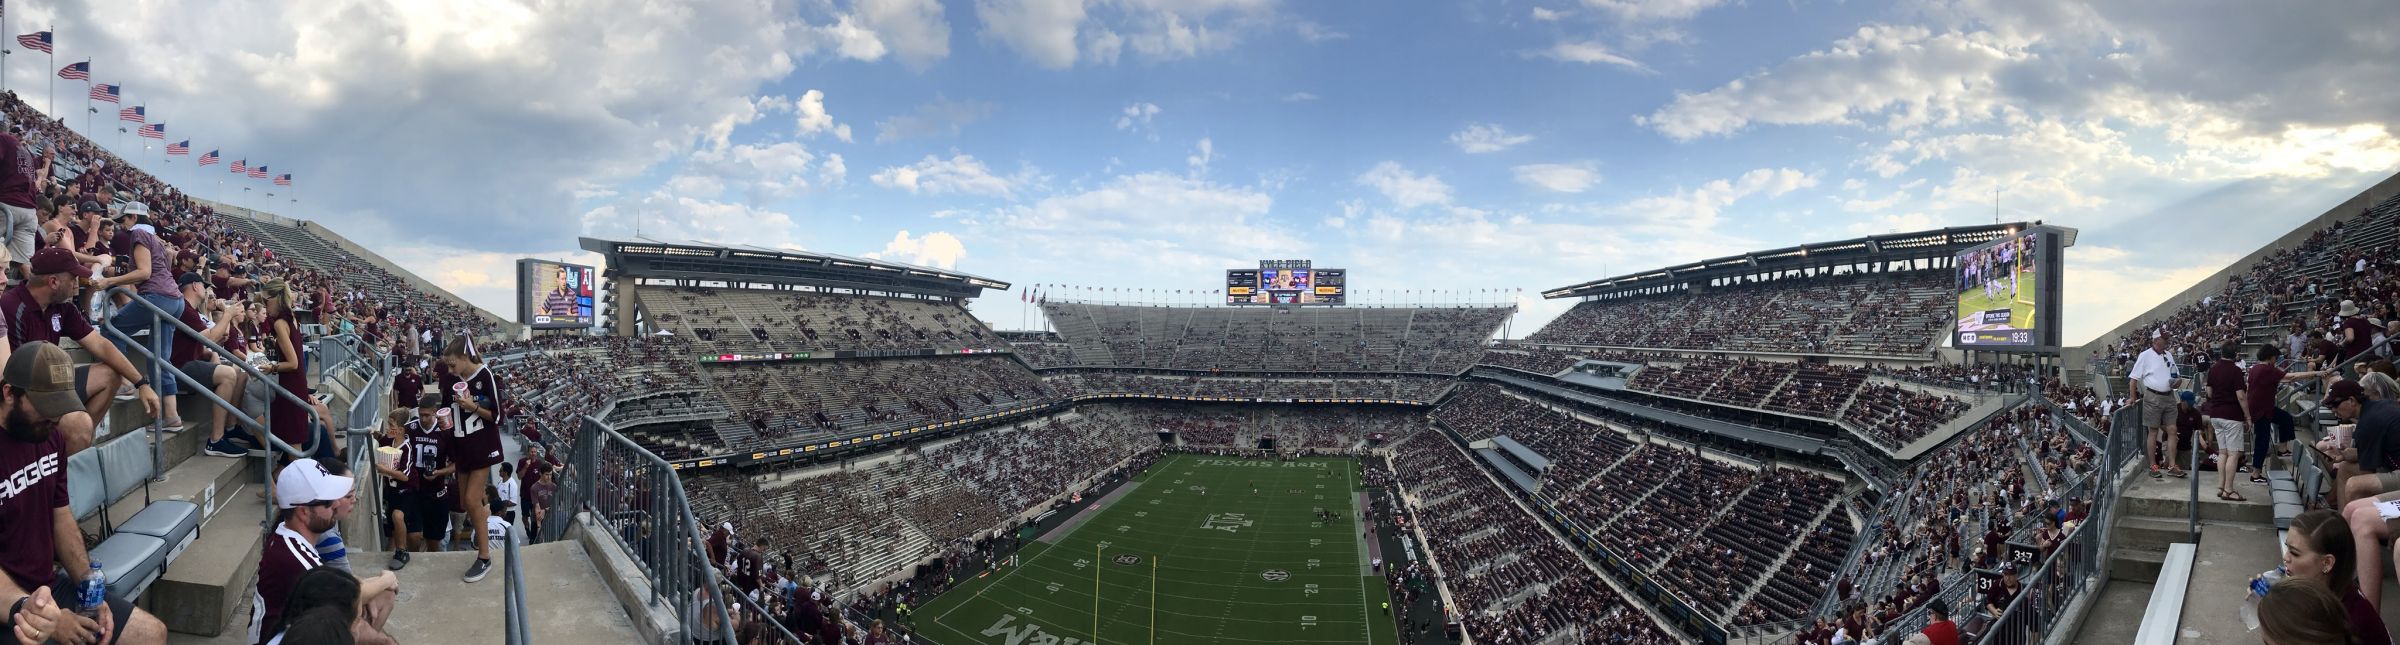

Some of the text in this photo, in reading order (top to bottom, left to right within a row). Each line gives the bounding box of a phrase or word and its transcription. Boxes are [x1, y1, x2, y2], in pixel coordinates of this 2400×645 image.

[1259, 259, 1312, 269] KYLE FIELD
[2011, 332, 2028, 343] 19:33
[2197, 355, 2205, 363] 12
[451, 403, 485, 438] 12
[1196, 459, 1273, 467] TEXAS
[2014, 550, 2033, 563] 317
[742, 557, 751, 576] 12
[1304, 583, 1319, 594] 20
[1979, 577, 1993, 591] 31
[1301, 615, 1317, 626] 10
